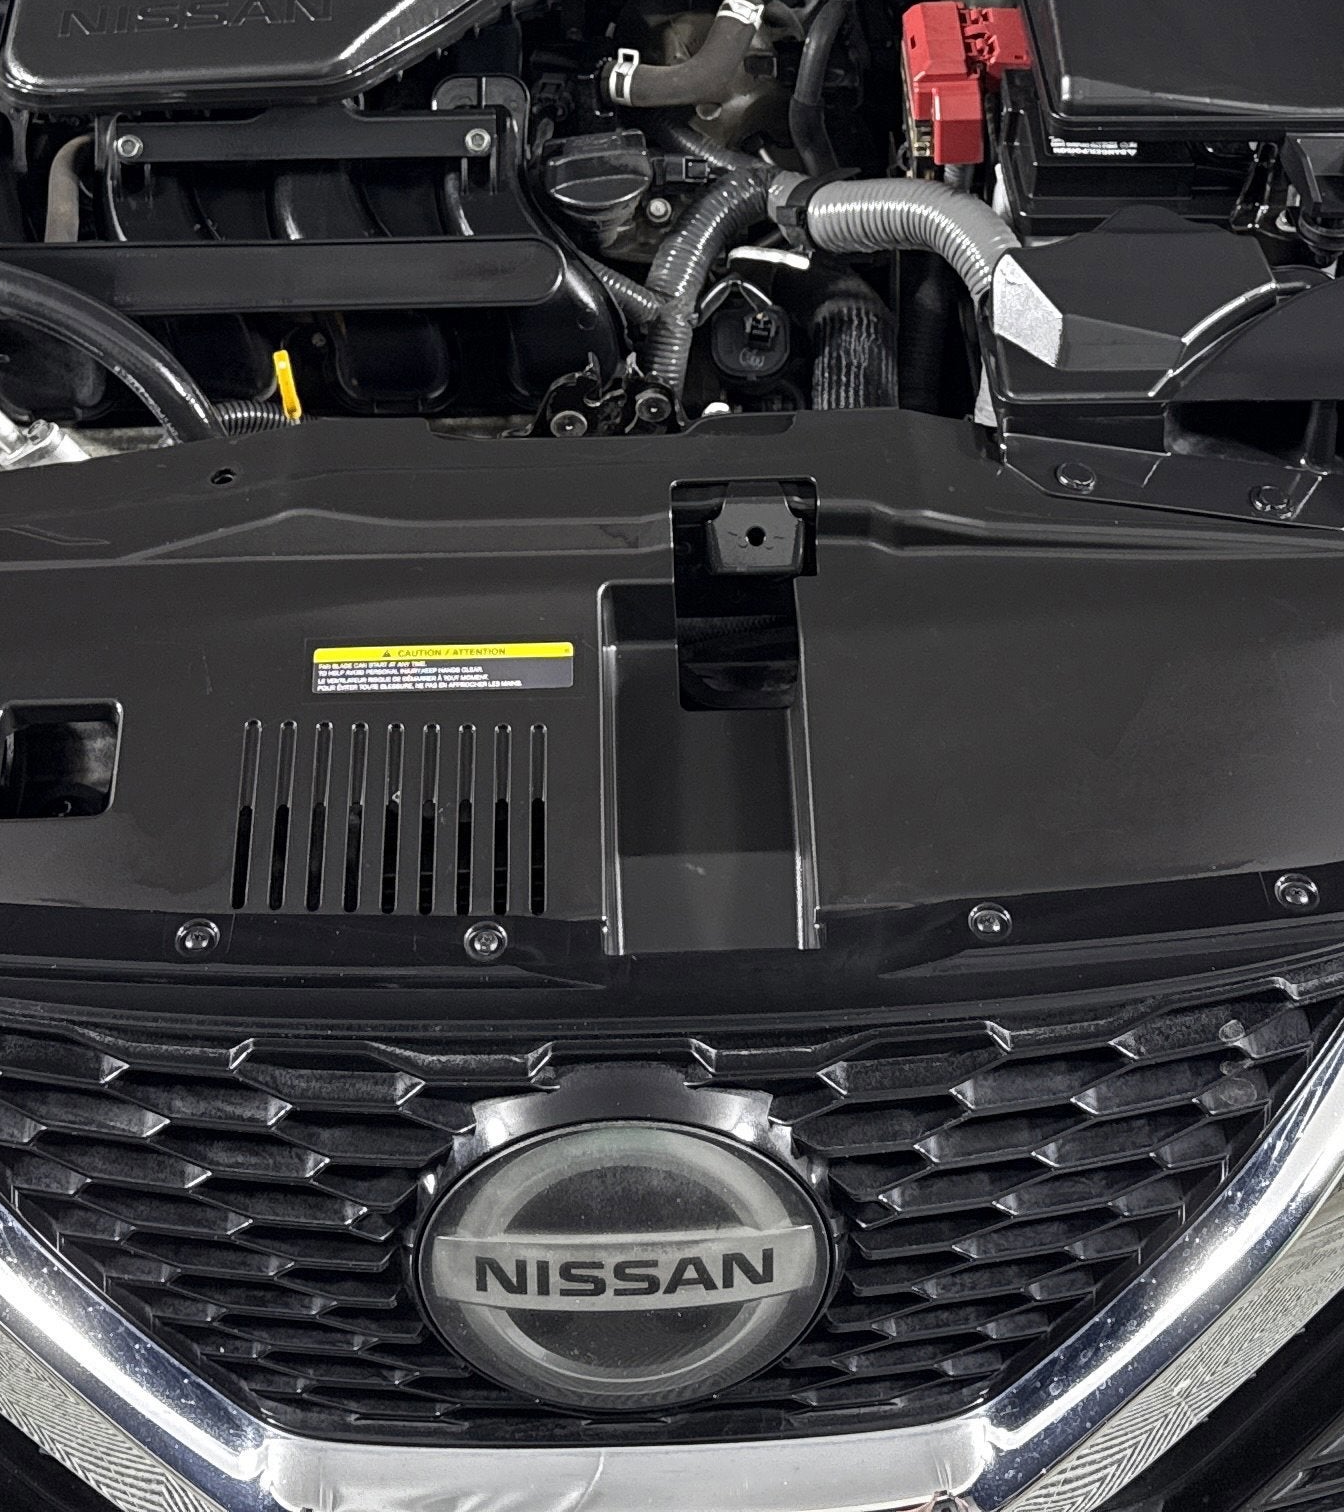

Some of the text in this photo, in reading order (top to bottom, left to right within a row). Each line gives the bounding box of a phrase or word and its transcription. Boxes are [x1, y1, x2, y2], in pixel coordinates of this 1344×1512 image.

[397, 649, 442, 658] CAUTION
[453, 647, 506, 657] ATTENTION
[475, 1248, 774, 1297] NISSAN
